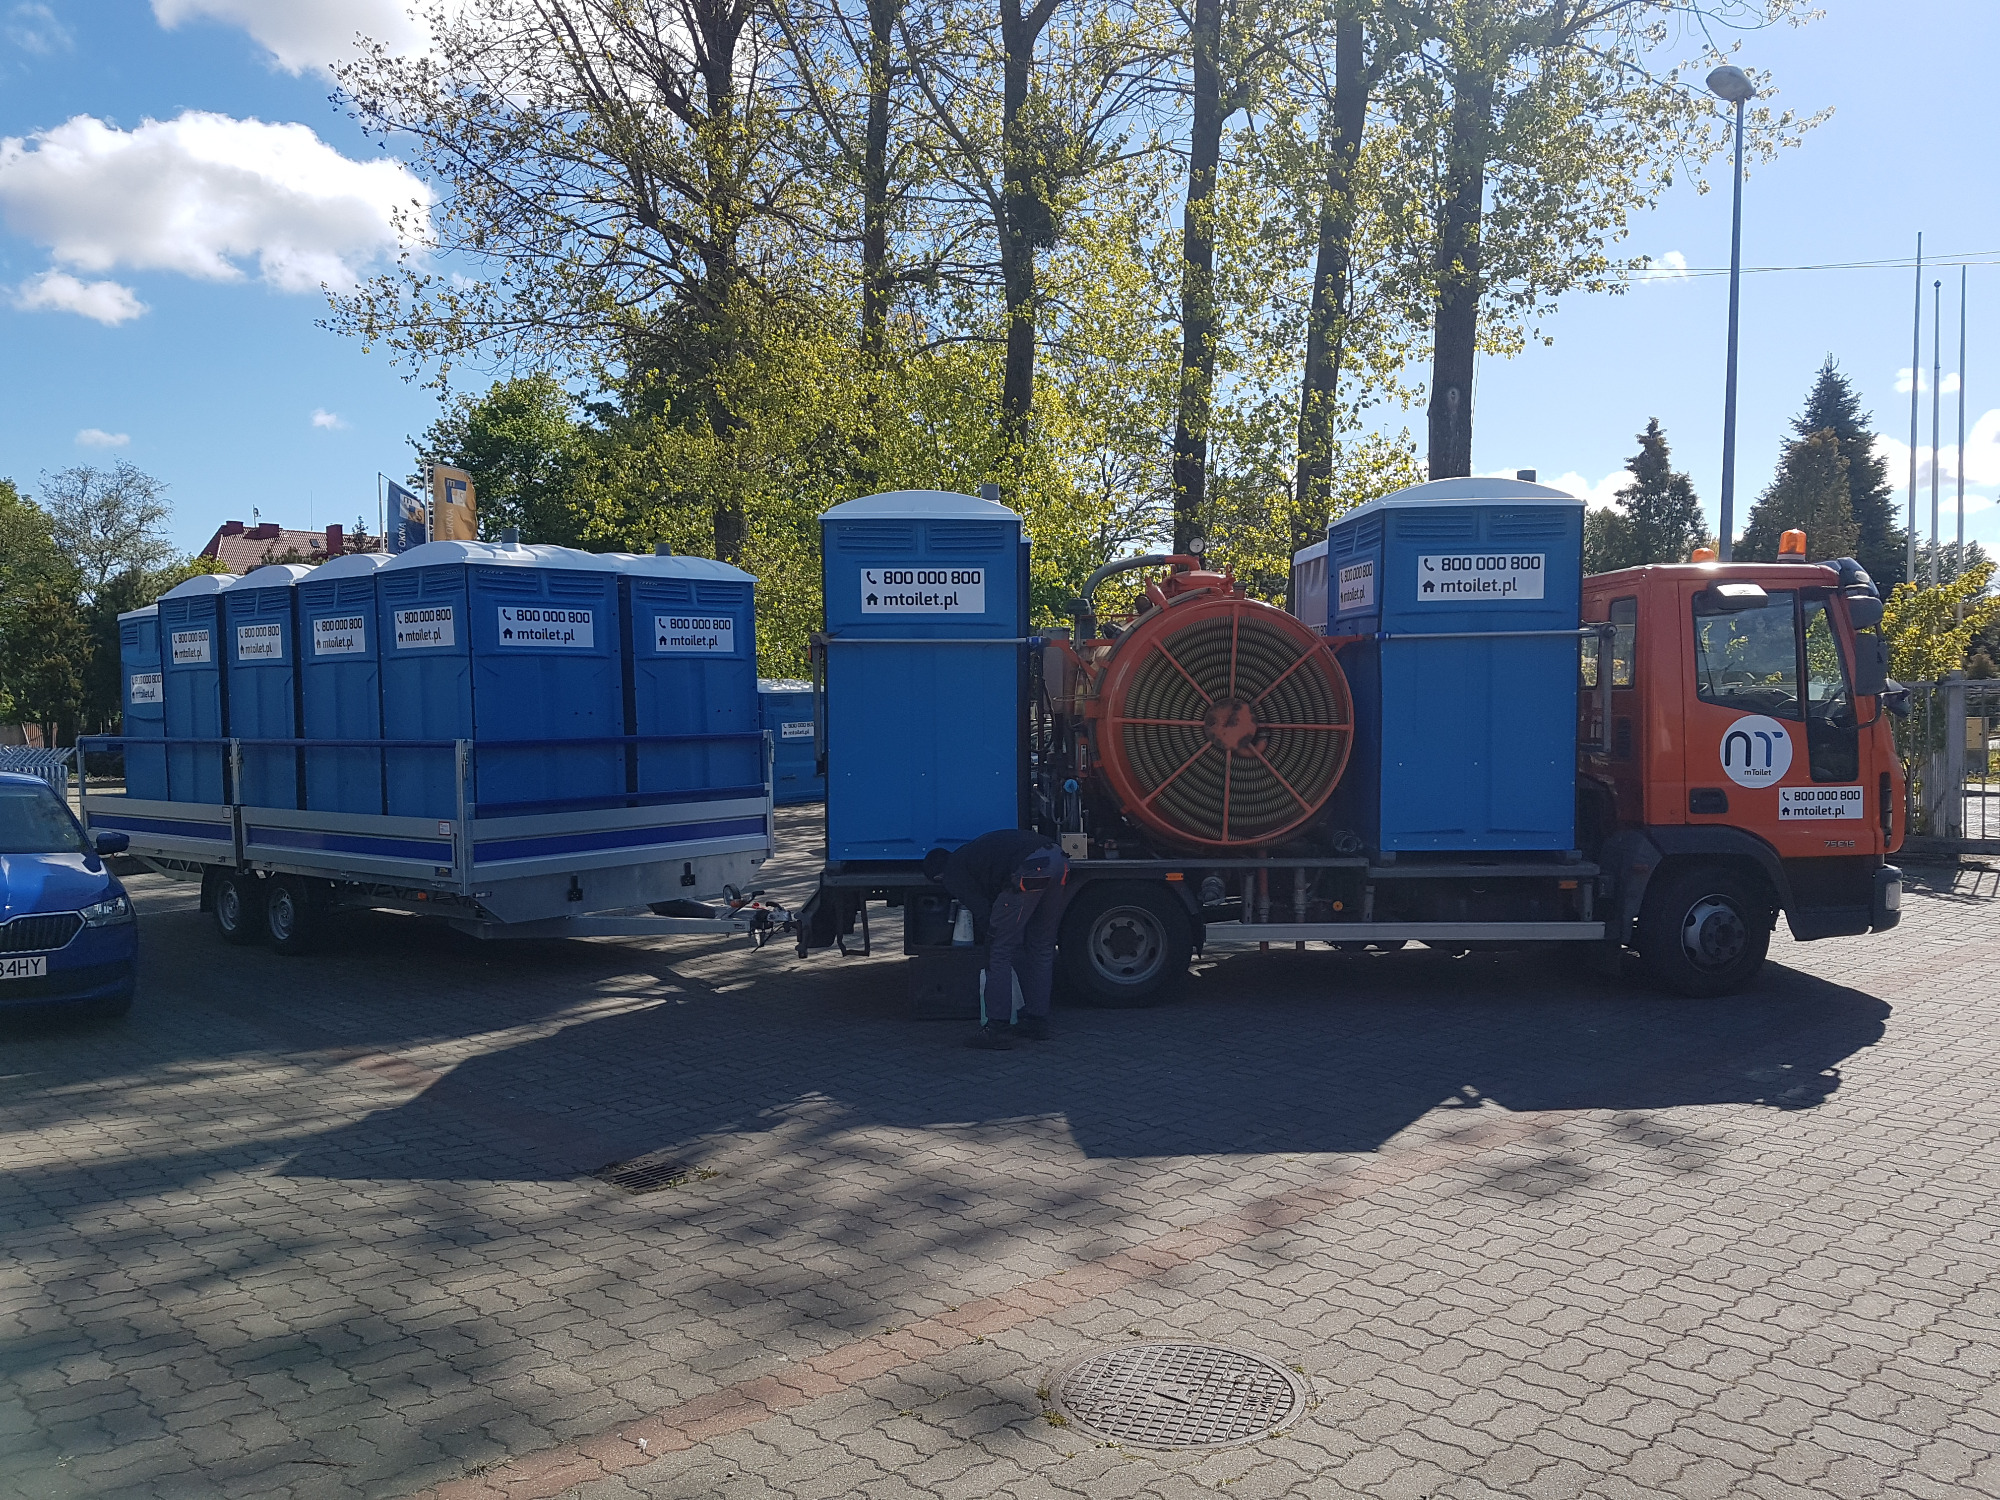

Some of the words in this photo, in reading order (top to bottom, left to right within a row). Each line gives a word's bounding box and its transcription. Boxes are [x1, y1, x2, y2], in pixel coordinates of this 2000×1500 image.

[446, 508, 454, 535] OKNA
[398, 522, 406, 548] OKNA
[1442, 558, 1472, 571] 800
[1476, 557, 1506, 570] 000
[1510, 556, 1540, 570] 800
[884, 571, 913, 584] 800
[918, 571, 947, 584] 000
[951, 571, 980, 584] 800
[1353, 566, 1362, 580] 000
[1363, 563, 1372, 577] 800
[1344, 584, 1365, 603] mtoilet.pl
[1440, 577, 1517, 596] mtoilet.pl
[884, 592, 958, 610] mtoilet.pl
[404, 612, 418, 623] 800
[420, 610, 434, 622] 000
[436, 608, 451, 621] 800
[516, 610, 540, 621] 800
[542, 611, 566, 622] 000
[568, 612, 590, 623] 800
[322, 620, 334, 632] 800
[335, 620, 347, 630] 000
[349, 618, 362, 629] 800
[670, 618, 690, 629] 800
[692, 619, 710, 630] 000
[713, 619, 730, 630] 800
[178, 634, 187, 643] 800
[188, 633, 198, 642] 000
[199, 631, 208, 641] 800
[244, 628, 254, 638] 800
[256, 627, 266, 637] 000
[268, 626, 279, 636] 800
[405, 627, 441, 644] mtoilet.pl
[518, 628, 575, 644] mtoilet.pl
[245, 642, 272, 656] mtoilet.pl
[323, 635, 354, 650] mtoilet.pl
[670, 635, 718, 649] mtoilet.pl
[179, 647, 203, 660] mtoilet.pl
[1744, 768, 1771, 776] mToilet
[1794, 791, 1814, 801] 800
[1817, 791, 1837, 800] 000
[1840, 790, 1860, 800] 800
[1794, 805, 1845, 818] mtoilet.pl
